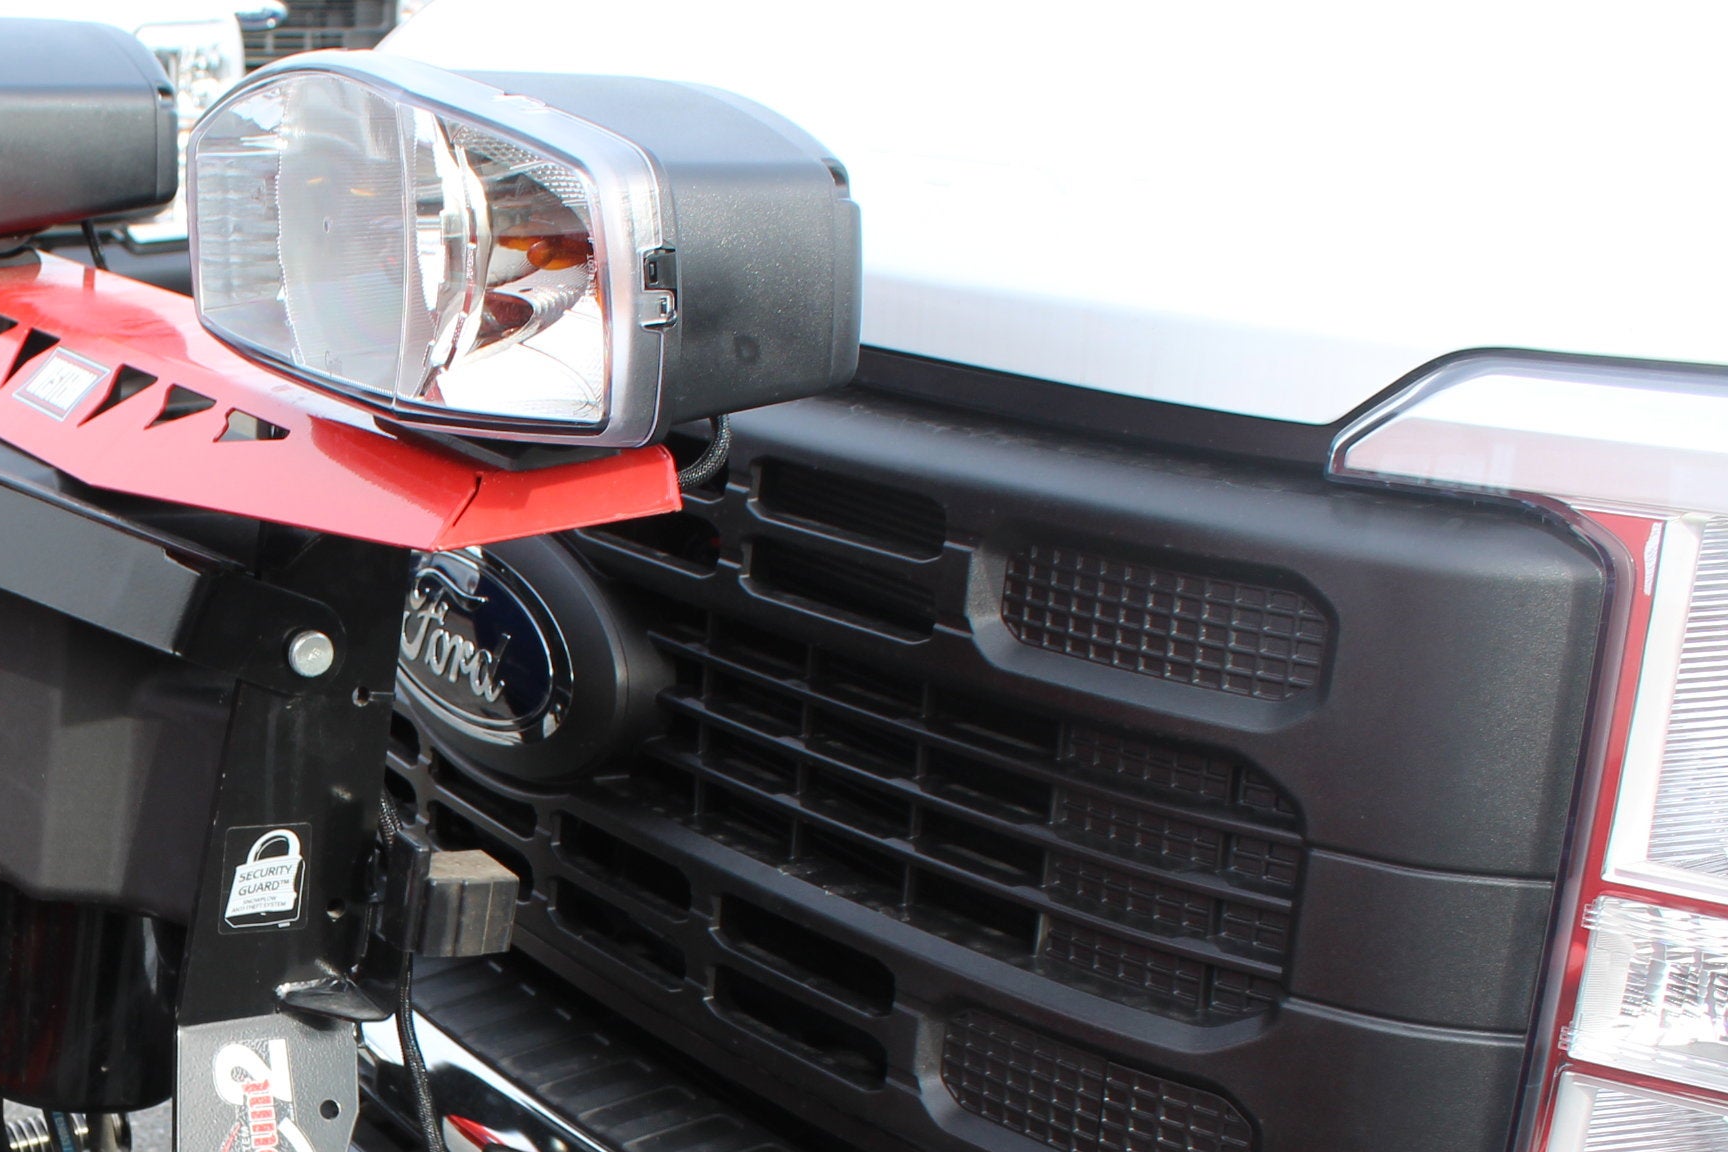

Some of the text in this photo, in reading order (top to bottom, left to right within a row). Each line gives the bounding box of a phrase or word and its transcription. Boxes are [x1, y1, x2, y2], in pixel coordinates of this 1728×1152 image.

[400, 567, 511, 702] Ford
[239, 864, 293, 883] SECURITY
[212, 1038, 293, 1106] 2
